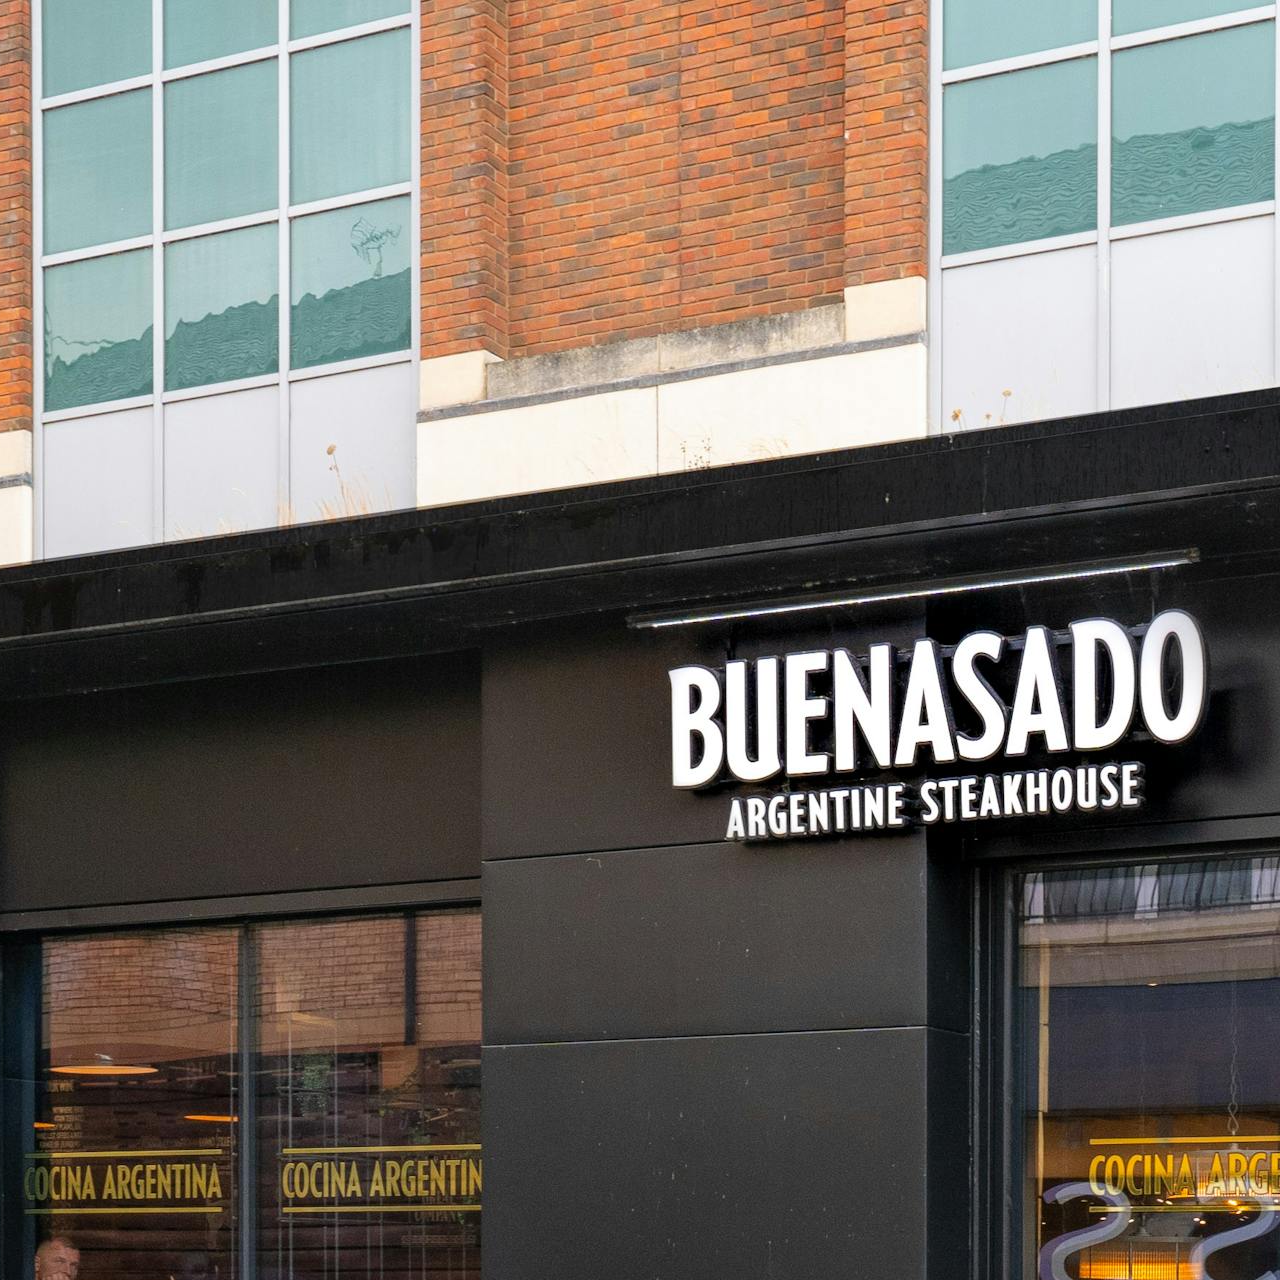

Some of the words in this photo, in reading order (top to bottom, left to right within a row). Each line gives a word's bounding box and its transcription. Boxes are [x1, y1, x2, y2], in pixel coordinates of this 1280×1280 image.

[669, 608, 1207, 788] BUENASADO
[724, 783, 905, 841] ARGENTINE
[919, 762, 1142, 824] STEAKHOUSE
[23, 1165, 97, 1203] COCINA
[102, 1161, 223, 1201] ARGENTINA
[281, 1159, 363, 1199] COCINA
[1088, 1152, 1194, 1198] COCINA
